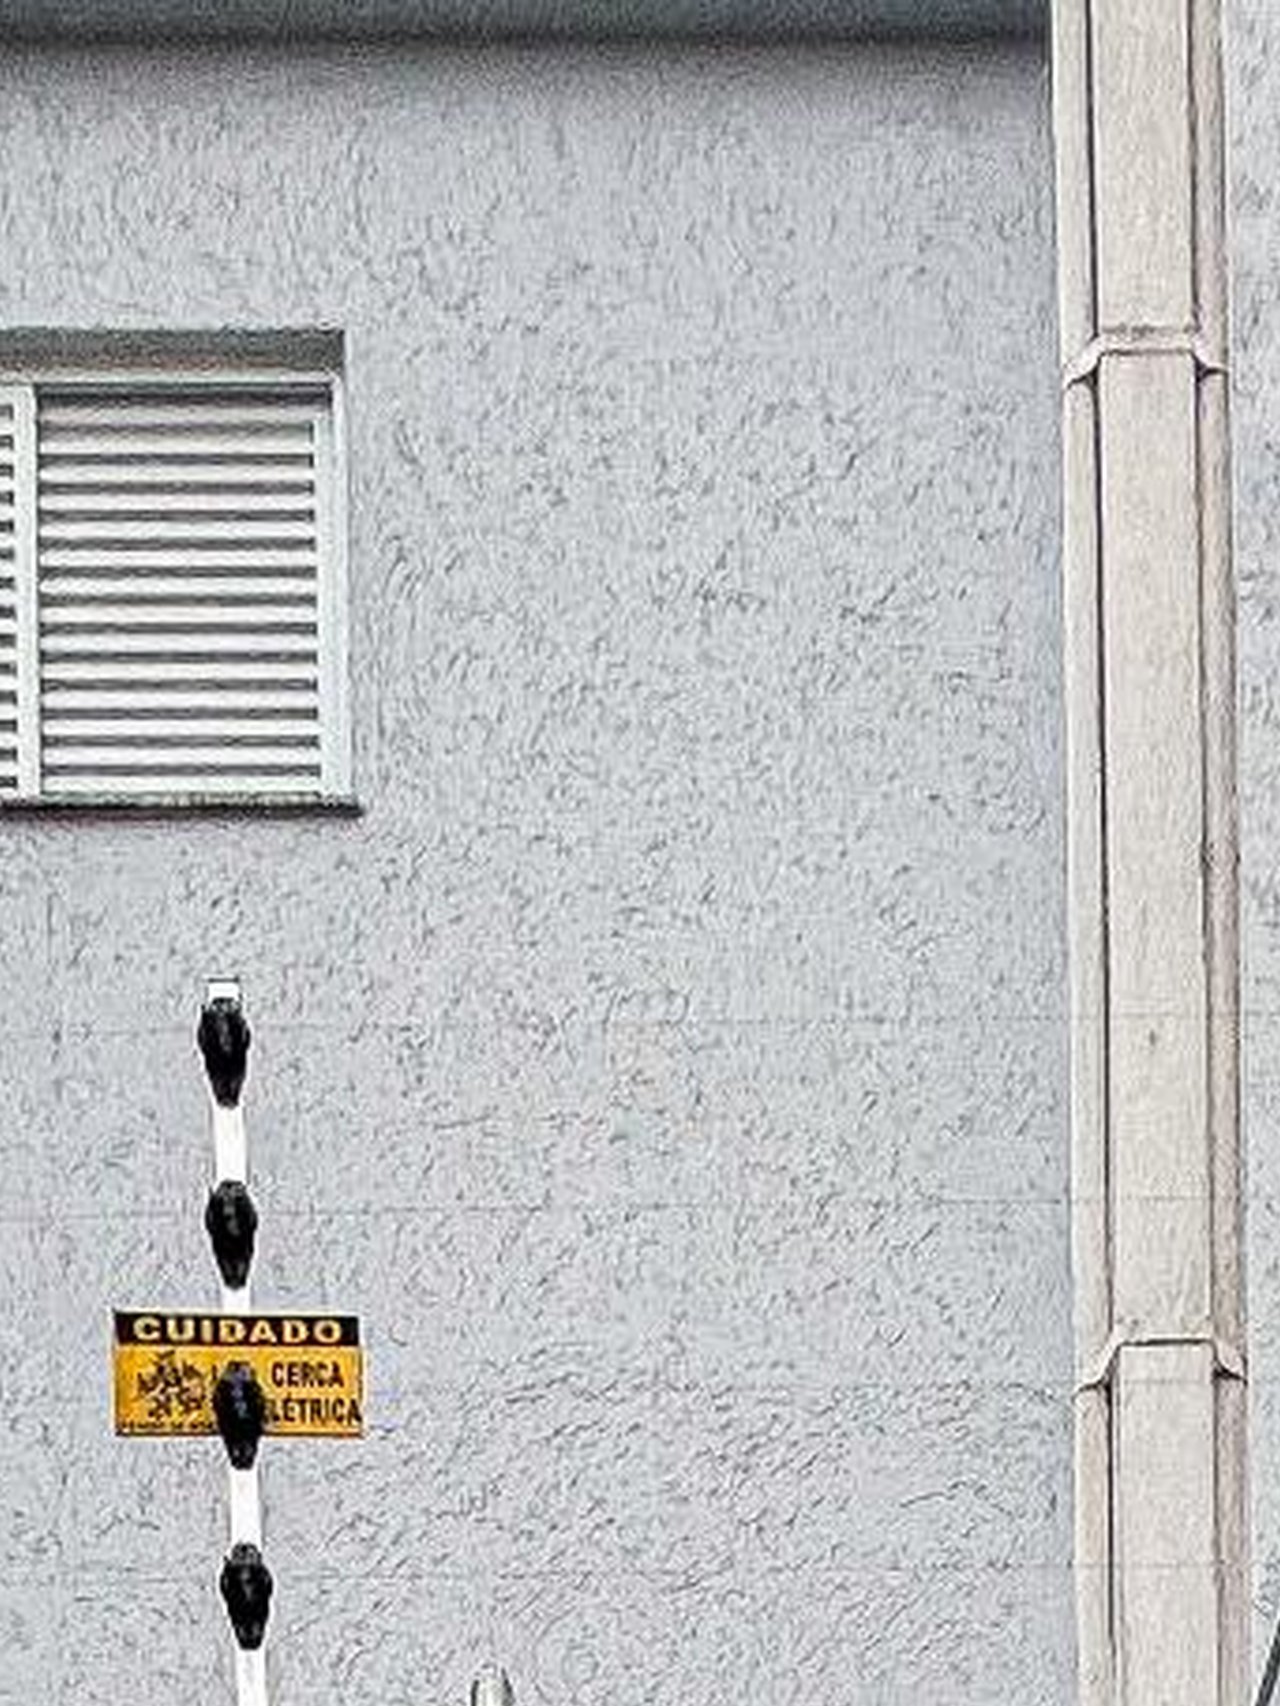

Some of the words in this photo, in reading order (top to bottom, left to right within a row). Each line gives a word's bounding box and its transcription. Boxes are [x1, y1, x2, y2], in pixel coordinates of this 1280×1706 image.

[132, 1316, 343, 1345] CUIDADO
[271, 1361, 345, 1388] CERCA
[263, 1394, 363, 1426] LÉTRICA
